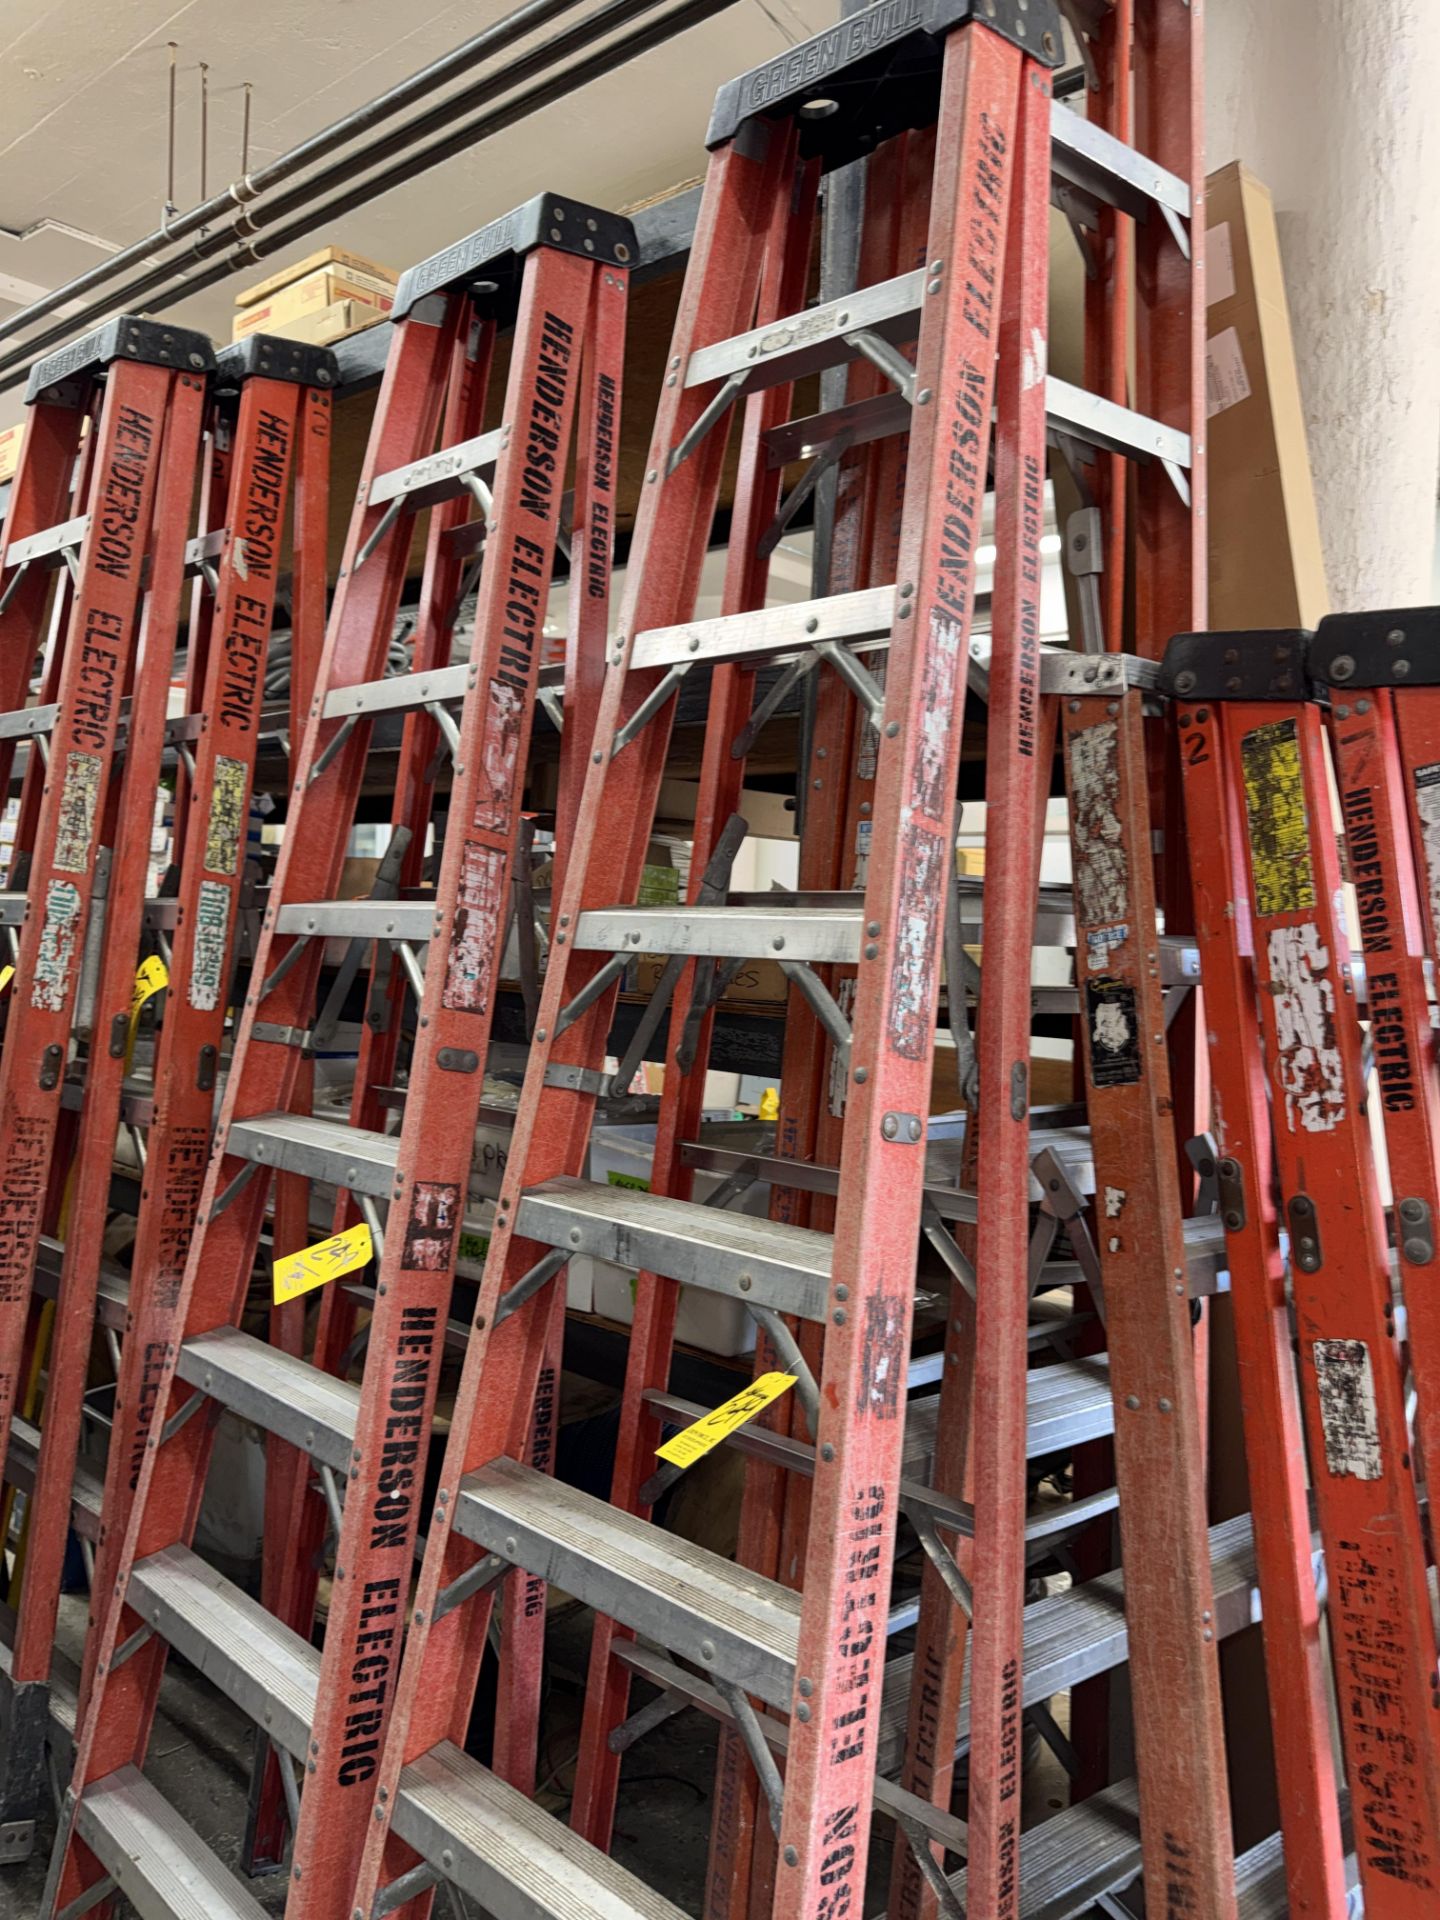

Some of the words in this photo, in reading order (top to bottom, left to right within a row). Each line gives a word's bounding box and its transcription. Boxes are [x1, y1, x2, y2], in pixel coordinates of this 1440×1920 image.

[748, 31, 839, 109] GREEN
[846, 0, 923, 61] BULL
[415, 243, 471, 293] GREEN
[469, 219, 514, 267] BULL
[519, 311, 575, 521] HENDERSON
[592, 373, 616, 491] HENDERSON
[94, 404, 155, 580] HENDERSON
[243, 408, 291, 581] HENDERSON
[588, 502, 610, 600] ELECTRIC
[1020, 455, 1042, 584] ELECTRIC
[71, 608, 124, 750] ELECTRIC
[219, 595, 268, 732] ELECTRIC
[497, 535, 546, 690] ELECTRI
[1018, 599, 1038, 757] HENDERSON
[1184, 732, 1210, 767] 2
[1415, 762, 1440, 780] SAFE
[1344, 785, 1393, 954] HENDERSON
[1369, 971, 1415, 1113] ELECTRIC
[373, 1307, 438, 1550] HENDERSON
[337, 1578, 400, 1789] ELECTRIC
[830, 1485, 887, 1767] ELECTRIC
[1000, 1658, 1017, 1803] ELECTRIC
